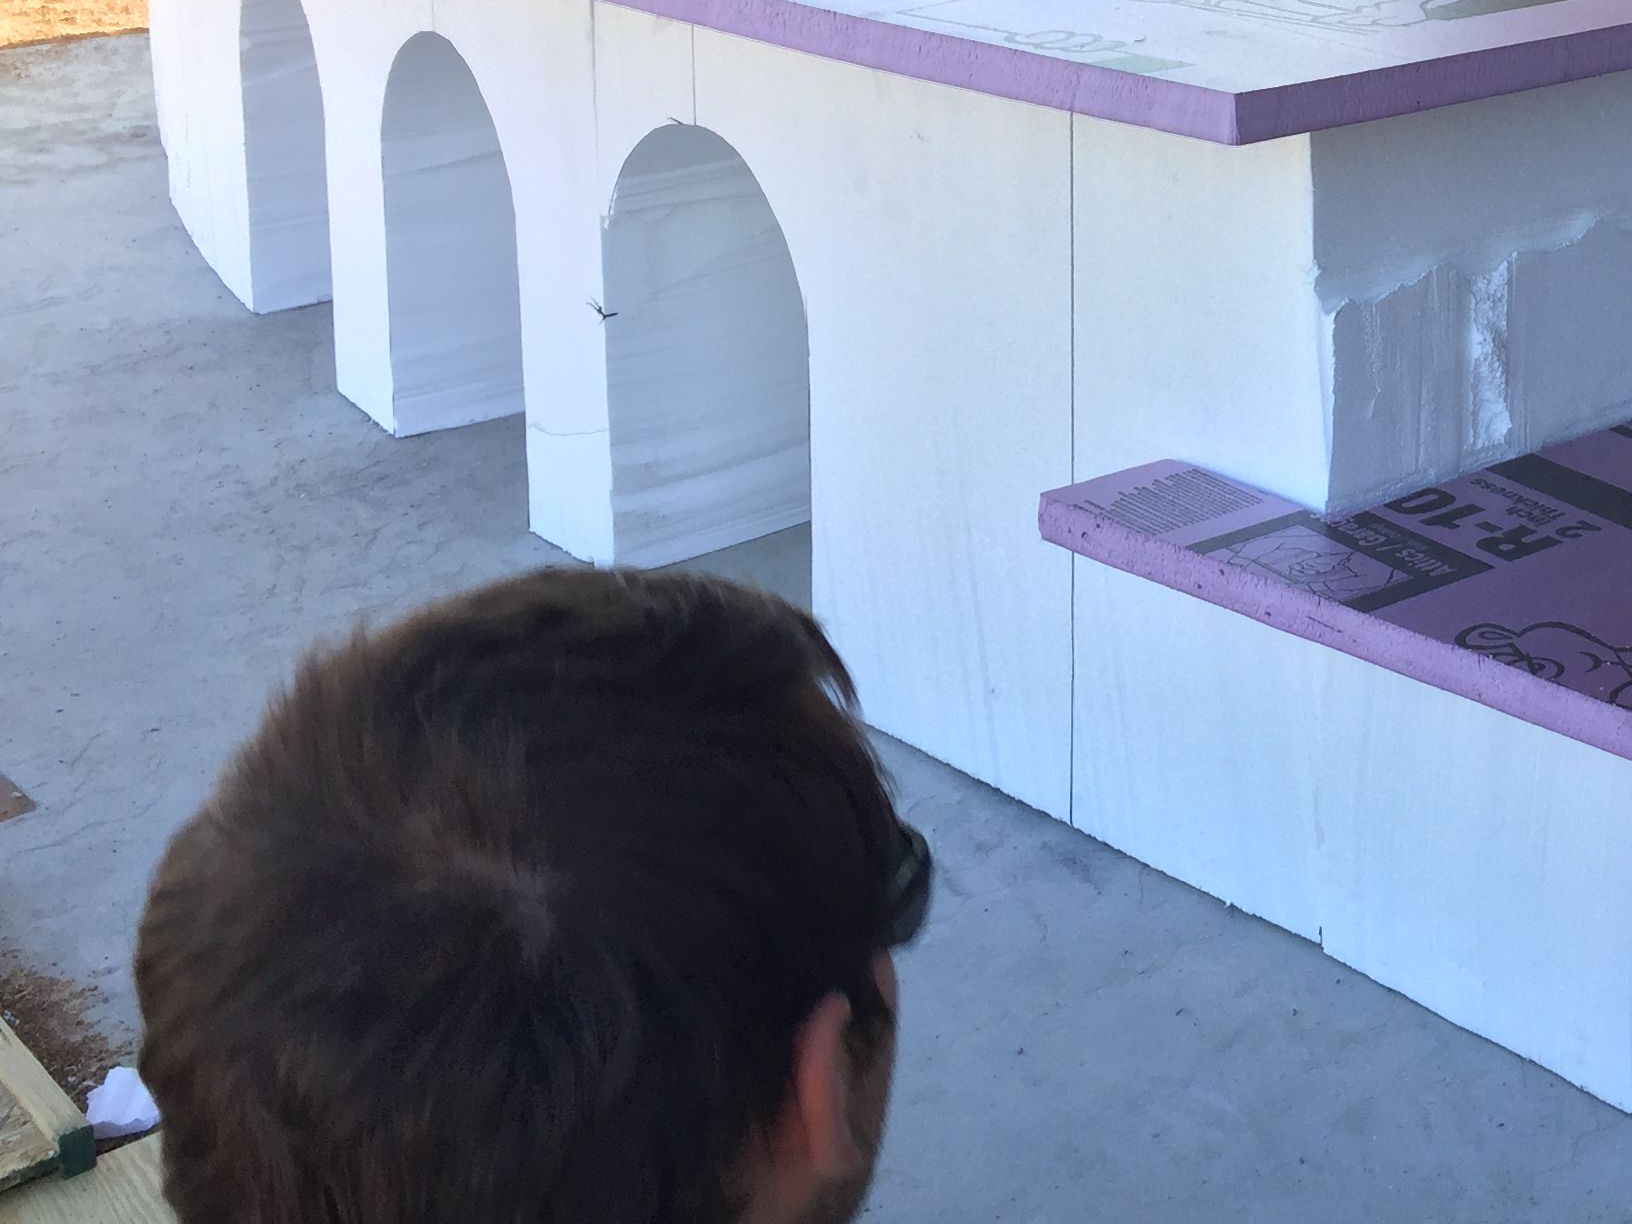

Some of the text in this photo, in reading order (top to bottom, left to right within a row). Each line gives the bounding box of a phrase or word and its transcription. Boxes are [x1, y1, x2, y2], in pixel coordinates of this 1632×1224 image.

[1470, 478, 1566, 521] Thickness
[1384, 487, 1563, 562] R-10
[1555, 520, 1602, 539] 2
[1395, 548, 1457, 576] Attics
